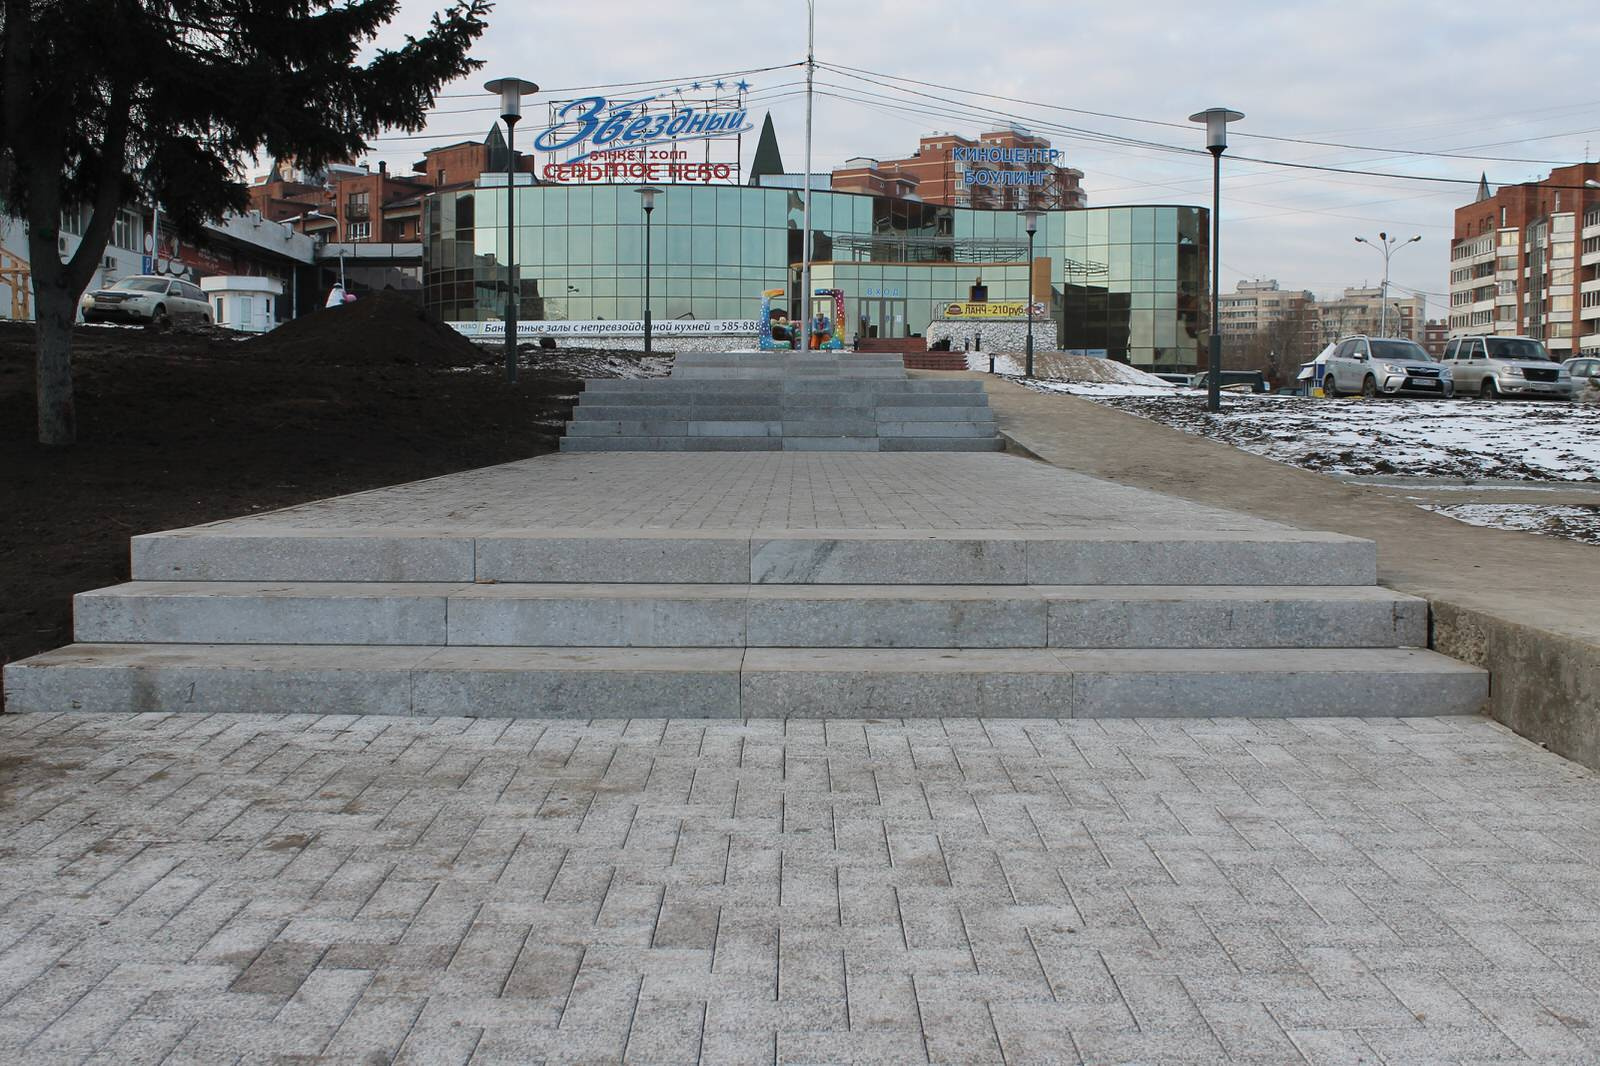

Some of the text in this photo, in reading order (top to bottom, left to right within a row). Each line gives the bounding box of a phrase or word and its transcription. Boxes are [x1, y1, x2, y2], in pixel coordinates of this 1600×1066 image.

[534, 96, 748, 151] Звездный
[952, 147, 1060, 163] КИНОЦЕНТР
[668, 162, 730, 181] НЕБО
[964, 171, 1049, 186] БОУЛИНГ
[866, 287, 900, 297] ВХОД
[484, 323, 544, 333] Бантные
[546, 324, 571, 332] залы
[580, 321, 673, 333] непревзойденой
[674, 321, 711, 333] кухней
